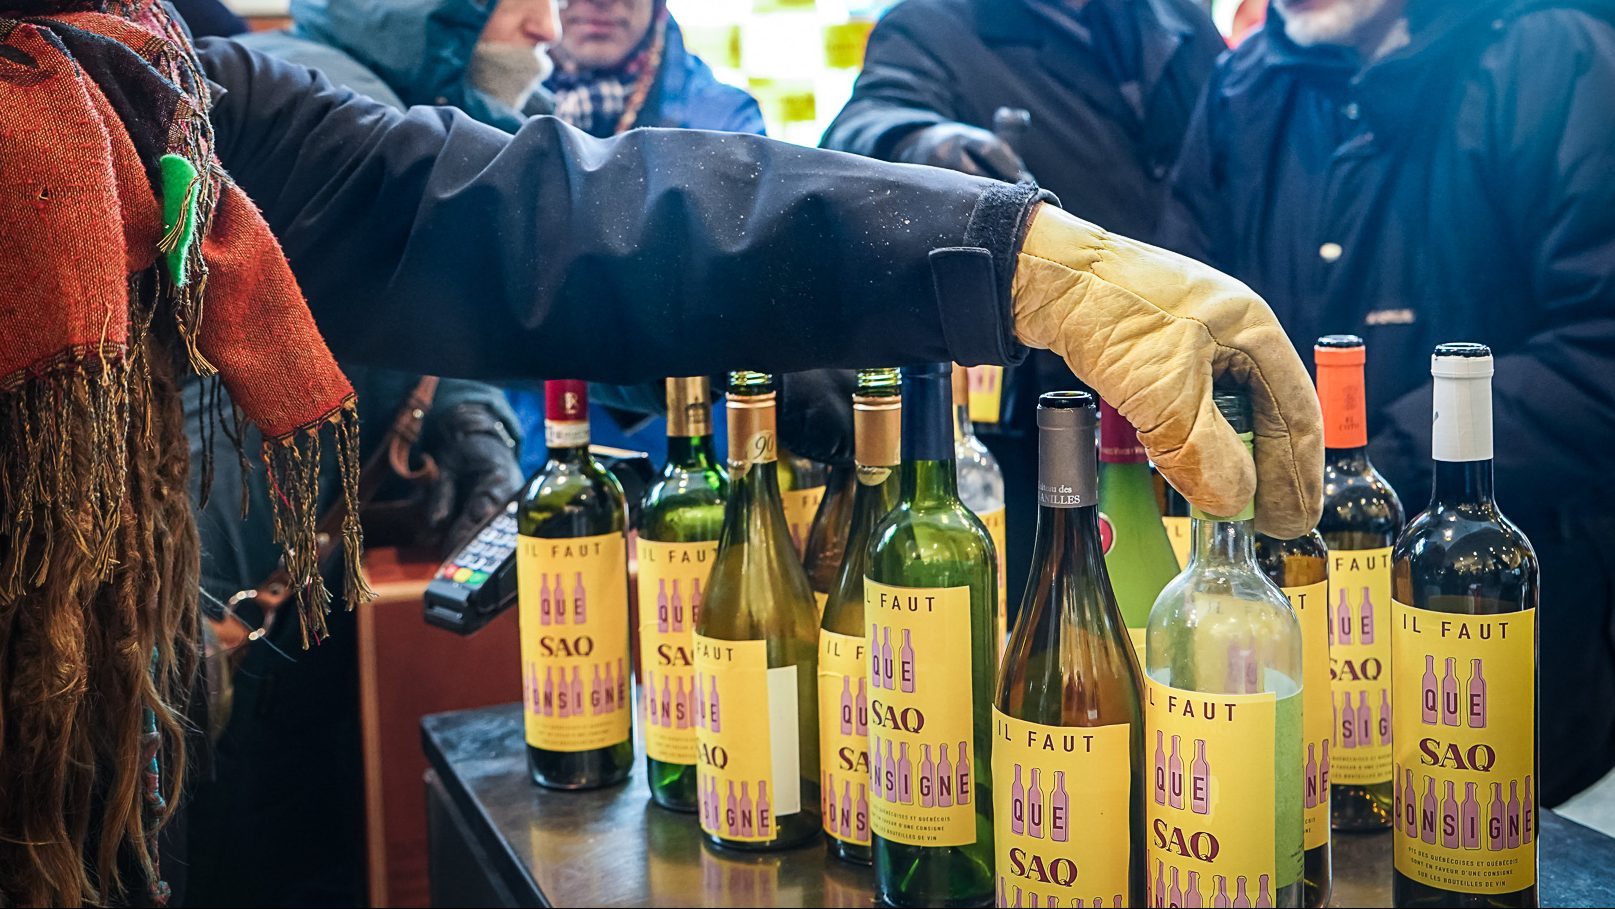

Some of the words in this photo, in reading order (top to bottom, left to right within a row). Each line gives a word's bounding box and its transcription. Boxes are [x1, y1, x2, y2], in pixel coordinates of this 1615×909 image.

[1058, 484, 1073, 494] des
[551, 542, 601, 557] FAUT
[1335, 554, 1388, 571] FAUT
[542, 598, 583, 616] QUE
[880, 593, 935, 612] FAUT
[1403, 613, 1421, 633] IL
[1441, 621, 1509, 639] FAUT
[540, 636, 594, 657] SAQ
[658, 643, 694, 666] SA
[827, 639, 840, 657] IL
[873, 655, 911, 682] QUE
[1168, 695, 1237, 722] FAUT
[1425, 688, 1482, 717] QUE
[871, 700, 925, 734] SAQ
[998, 719, 1012, 741] IL
[1027, 730, 1094, 753] FAUT
[1418, 737, 1496, 773] SAQ
[1156, 766, 1205, 801] QUE
[1014, 798, 1064, 830] QUE
[1395, 796, 1532, 839] CONSIGNE
[1153, 818, 1220, 863] SAQ
[1009, 847, 1078, 888] SAQ
[1430, 854, 1474, 867] QUÉBÉCOISES
[1435, 865, 1459, 875] FAVEUR
[1483, 869, 1513, 877] CONSIGNE
[1443, 877, 1483, 887] BOUTEILLES
